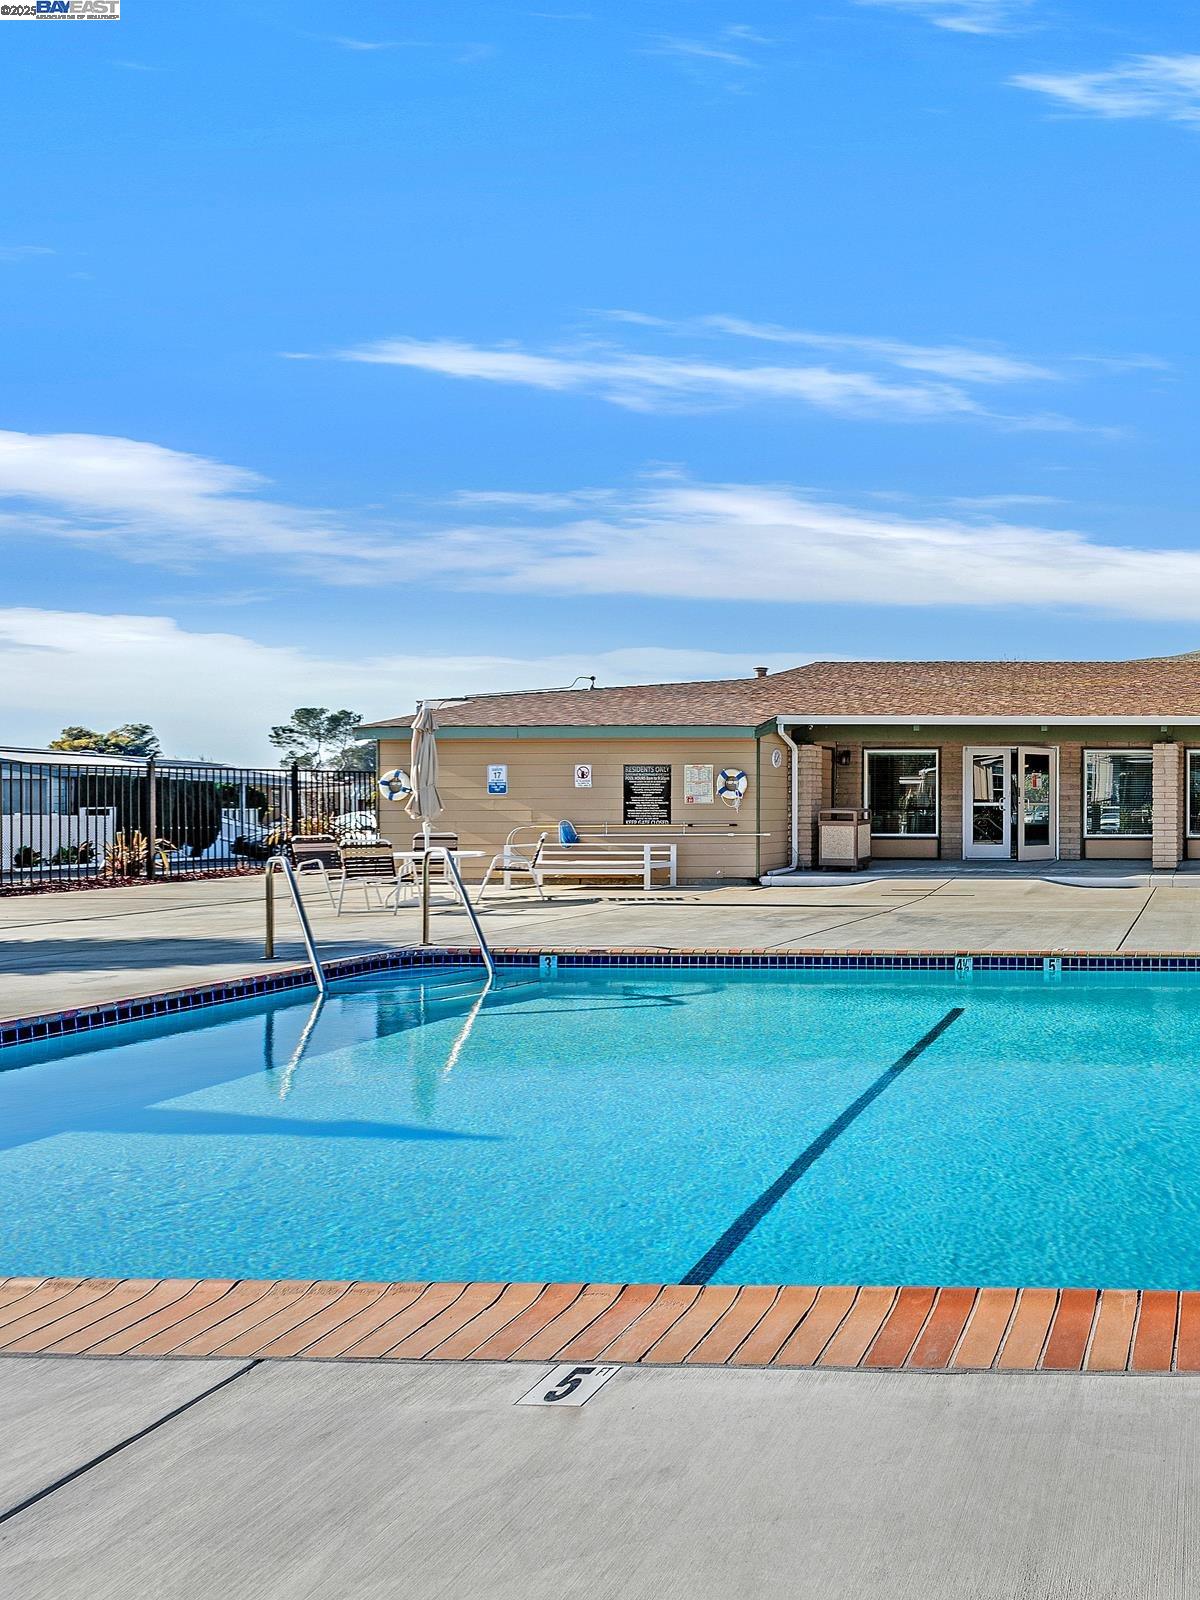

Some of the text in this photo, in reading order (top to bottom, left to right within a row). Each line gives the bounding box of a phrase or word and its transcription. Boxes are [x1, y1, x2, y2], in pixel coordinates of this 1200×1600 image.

[1049, 959, 1056, 971] 5
[544, 1367, 614, 1402] 5 FT
